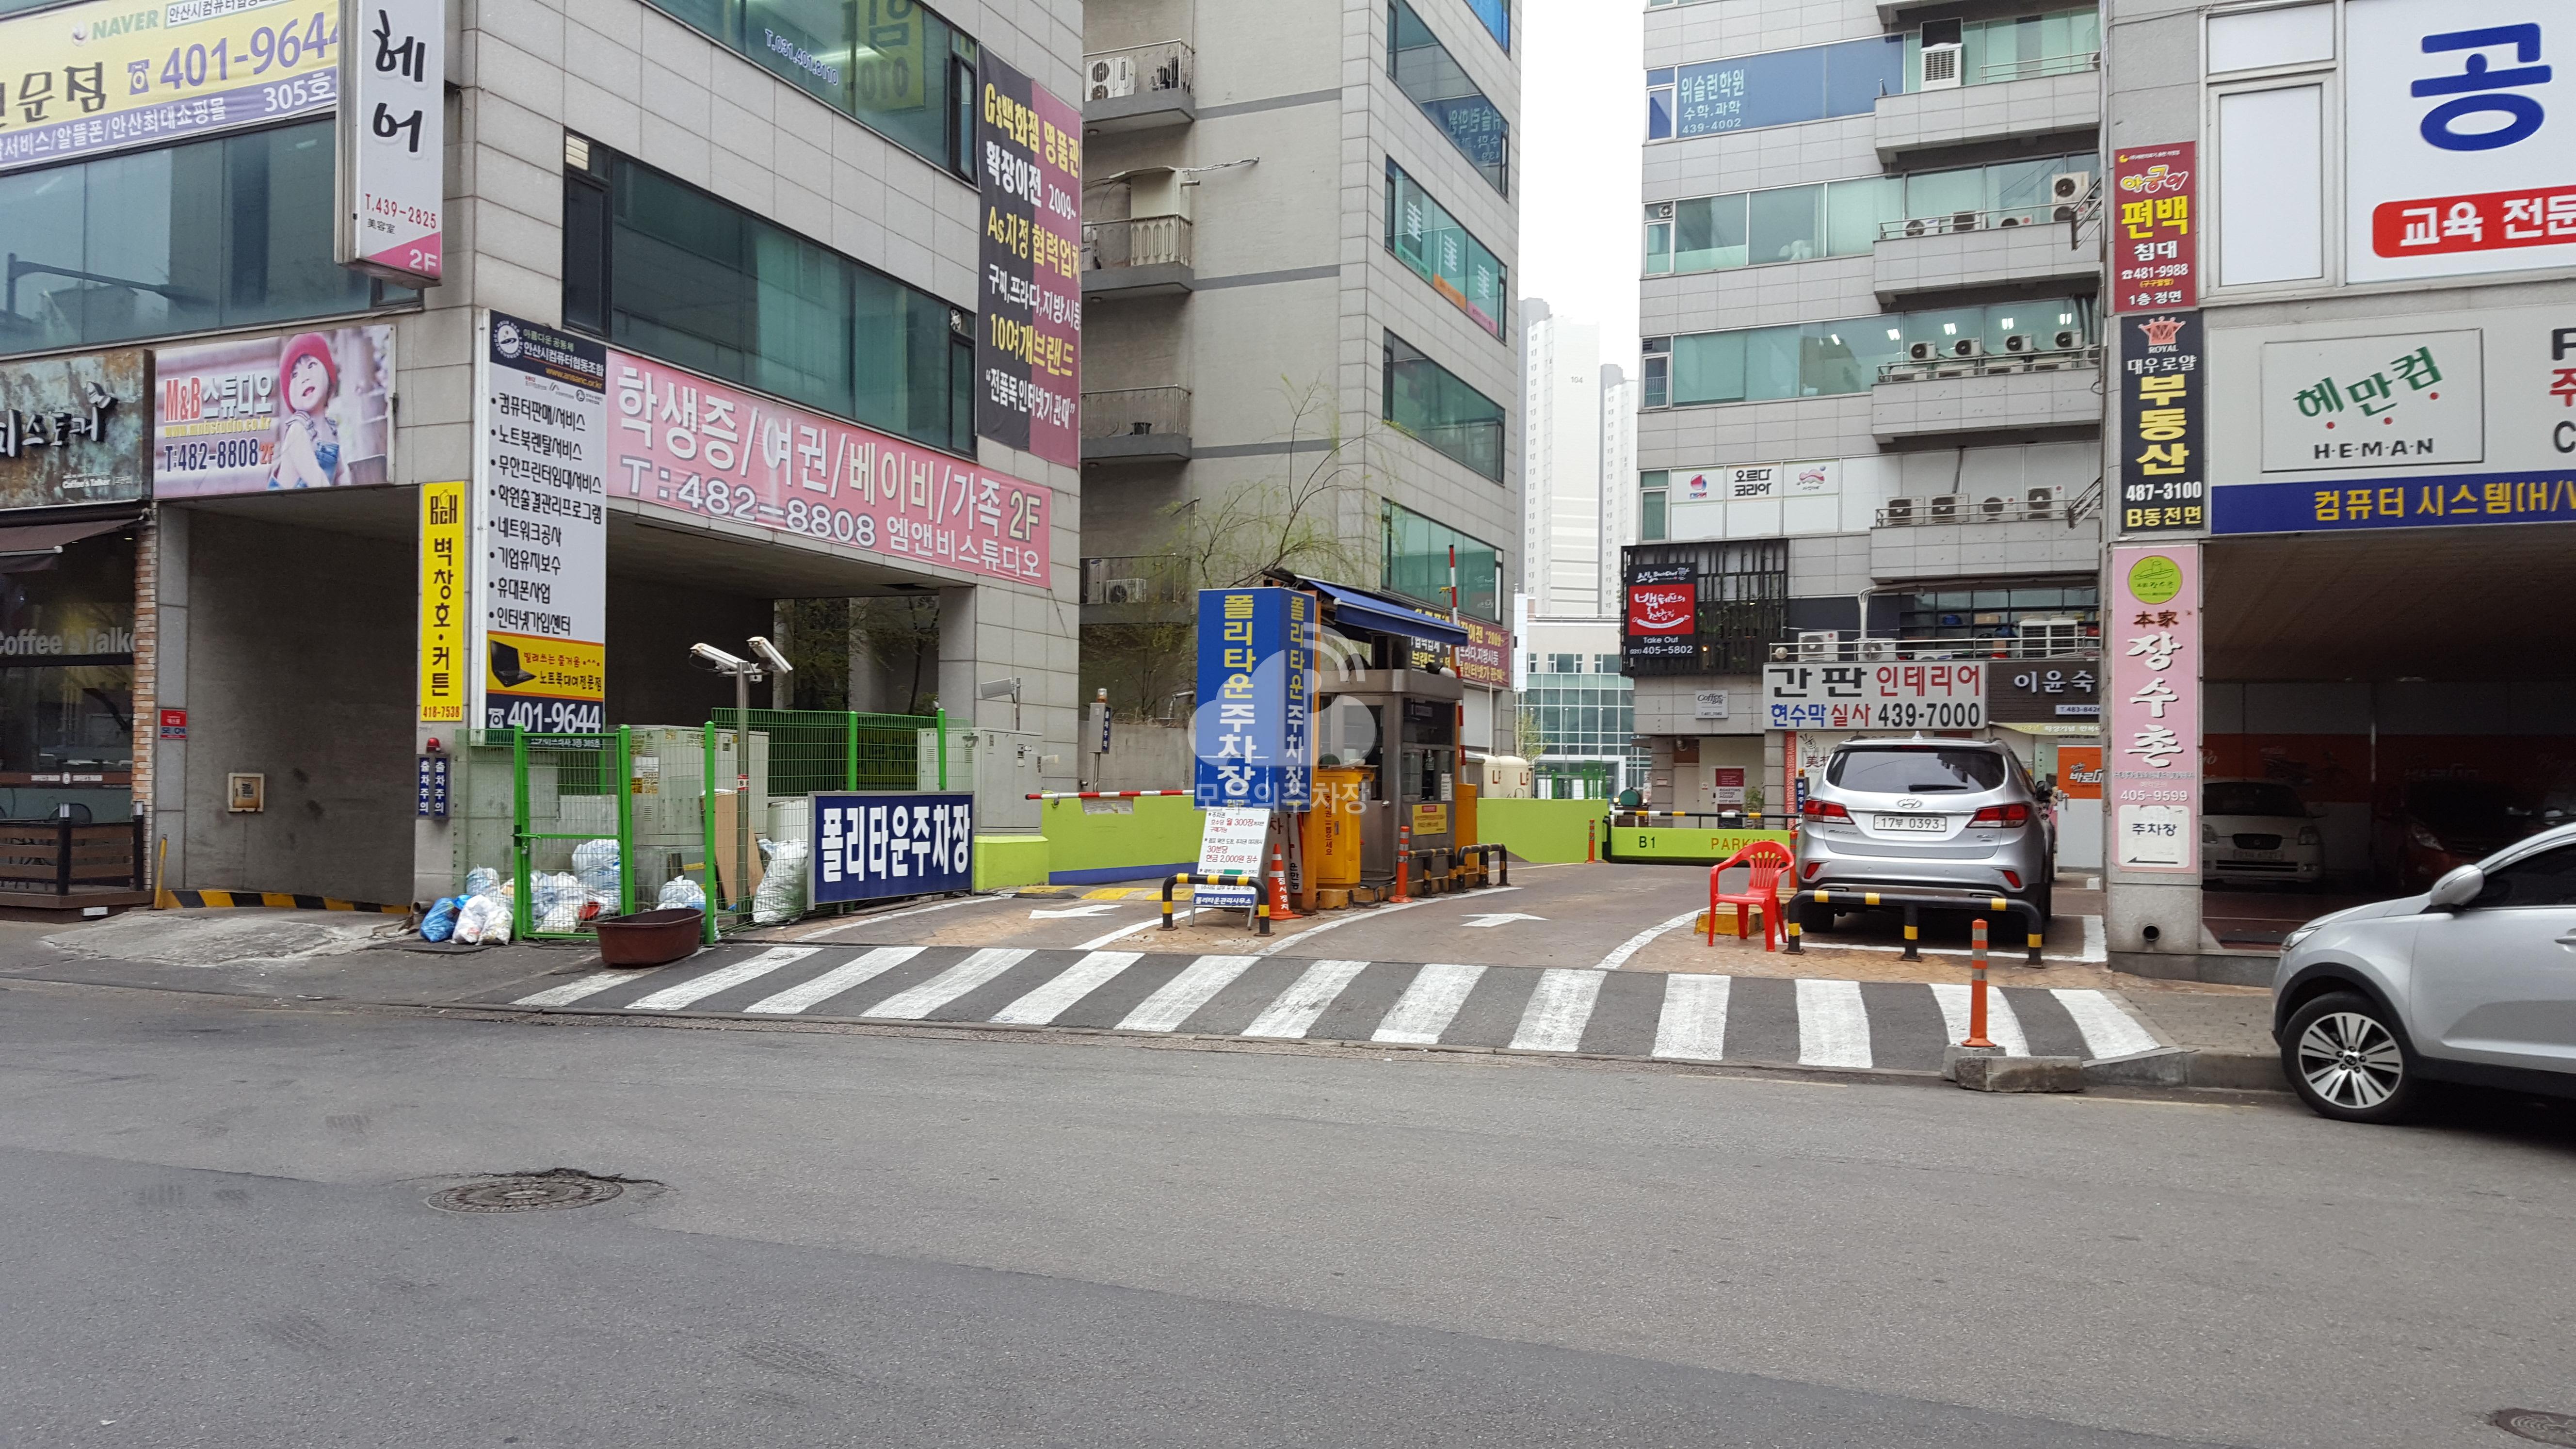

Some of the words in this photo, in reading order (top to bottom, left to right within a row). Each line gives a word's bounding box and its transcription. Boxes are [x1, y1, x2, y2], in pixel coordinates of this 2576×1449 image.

[92, 10, 159, 40] NAVER
[263, 71, 336, 113] 305호
[1682, 118, 1742, 134] 439-4002
[986, 141, 1042, 208] 확장이전
[365, 193, 437, 229] T.439-2825
[2121, 195, 2189, 240] 편백
[2400, 201, 2483, 247] 교육
[409, 248, 438, 271] 2F
[2134, 240, 2178, 261] 침대
[2134, 263, 2189, 280] 481-9988
[2128, 292, 2152, 306] 1층
[2154, 290, 2183, 305] 정면
[2148, 344, 2179, 354] ROYAL
[2127, 355, 2197, 375] 대우로얄
[499, 392, 586, 432] 컴퓨터판매/서비스
[2136, 373, 2190, 476] 부동산
[499, 424, 582, 461] 노트북렌탈서비스
[499, 455, 602, 494] 무한프린터임대서비스
[1734, 469, 1772, 483] 오르다
[499, 485, 602, 525] 학원출결관리프로그램
[1734, 483, 1772, 497] 코리아
[2125, 482, 2203, 502] 487-3100
[2314, 486, 2404, 521] 컴퓨터
[1010, 488, 1041, 542] 2F
[498, 516, 562, 547] 네트워크공사
[498, 547, 562, 576] 기업유지보수
[886, 515, 1042, 579] 엠앤비스튜디오
[497, 577, 550, 604] 휴대폰사업
[497, 607, 571, 636] 인터넷가입센터
[2132, 610, 2179, 628] 本家
[1876, 665, 1980, 697] 인테리어
[2013, 669, 2097, 693] 이윤숙
[507, 701, 602, 734] 401-9644
[1771, 703, 1826, 727] 현수막
[1878, 702, 1980, 727] 439-7000
[419, 760, 430, 813] 출차주의
[434, 760, 445, 813] 출차주의
[2120, 790, 2189, 802] 405-9599
[1881, 817, 1903, 828] 17부
[1909, 818, 1940, 829] 0393
[2132, 823, 2177, 837] 주차장
[821, 804, 970, 883] 폴리타운주차장
